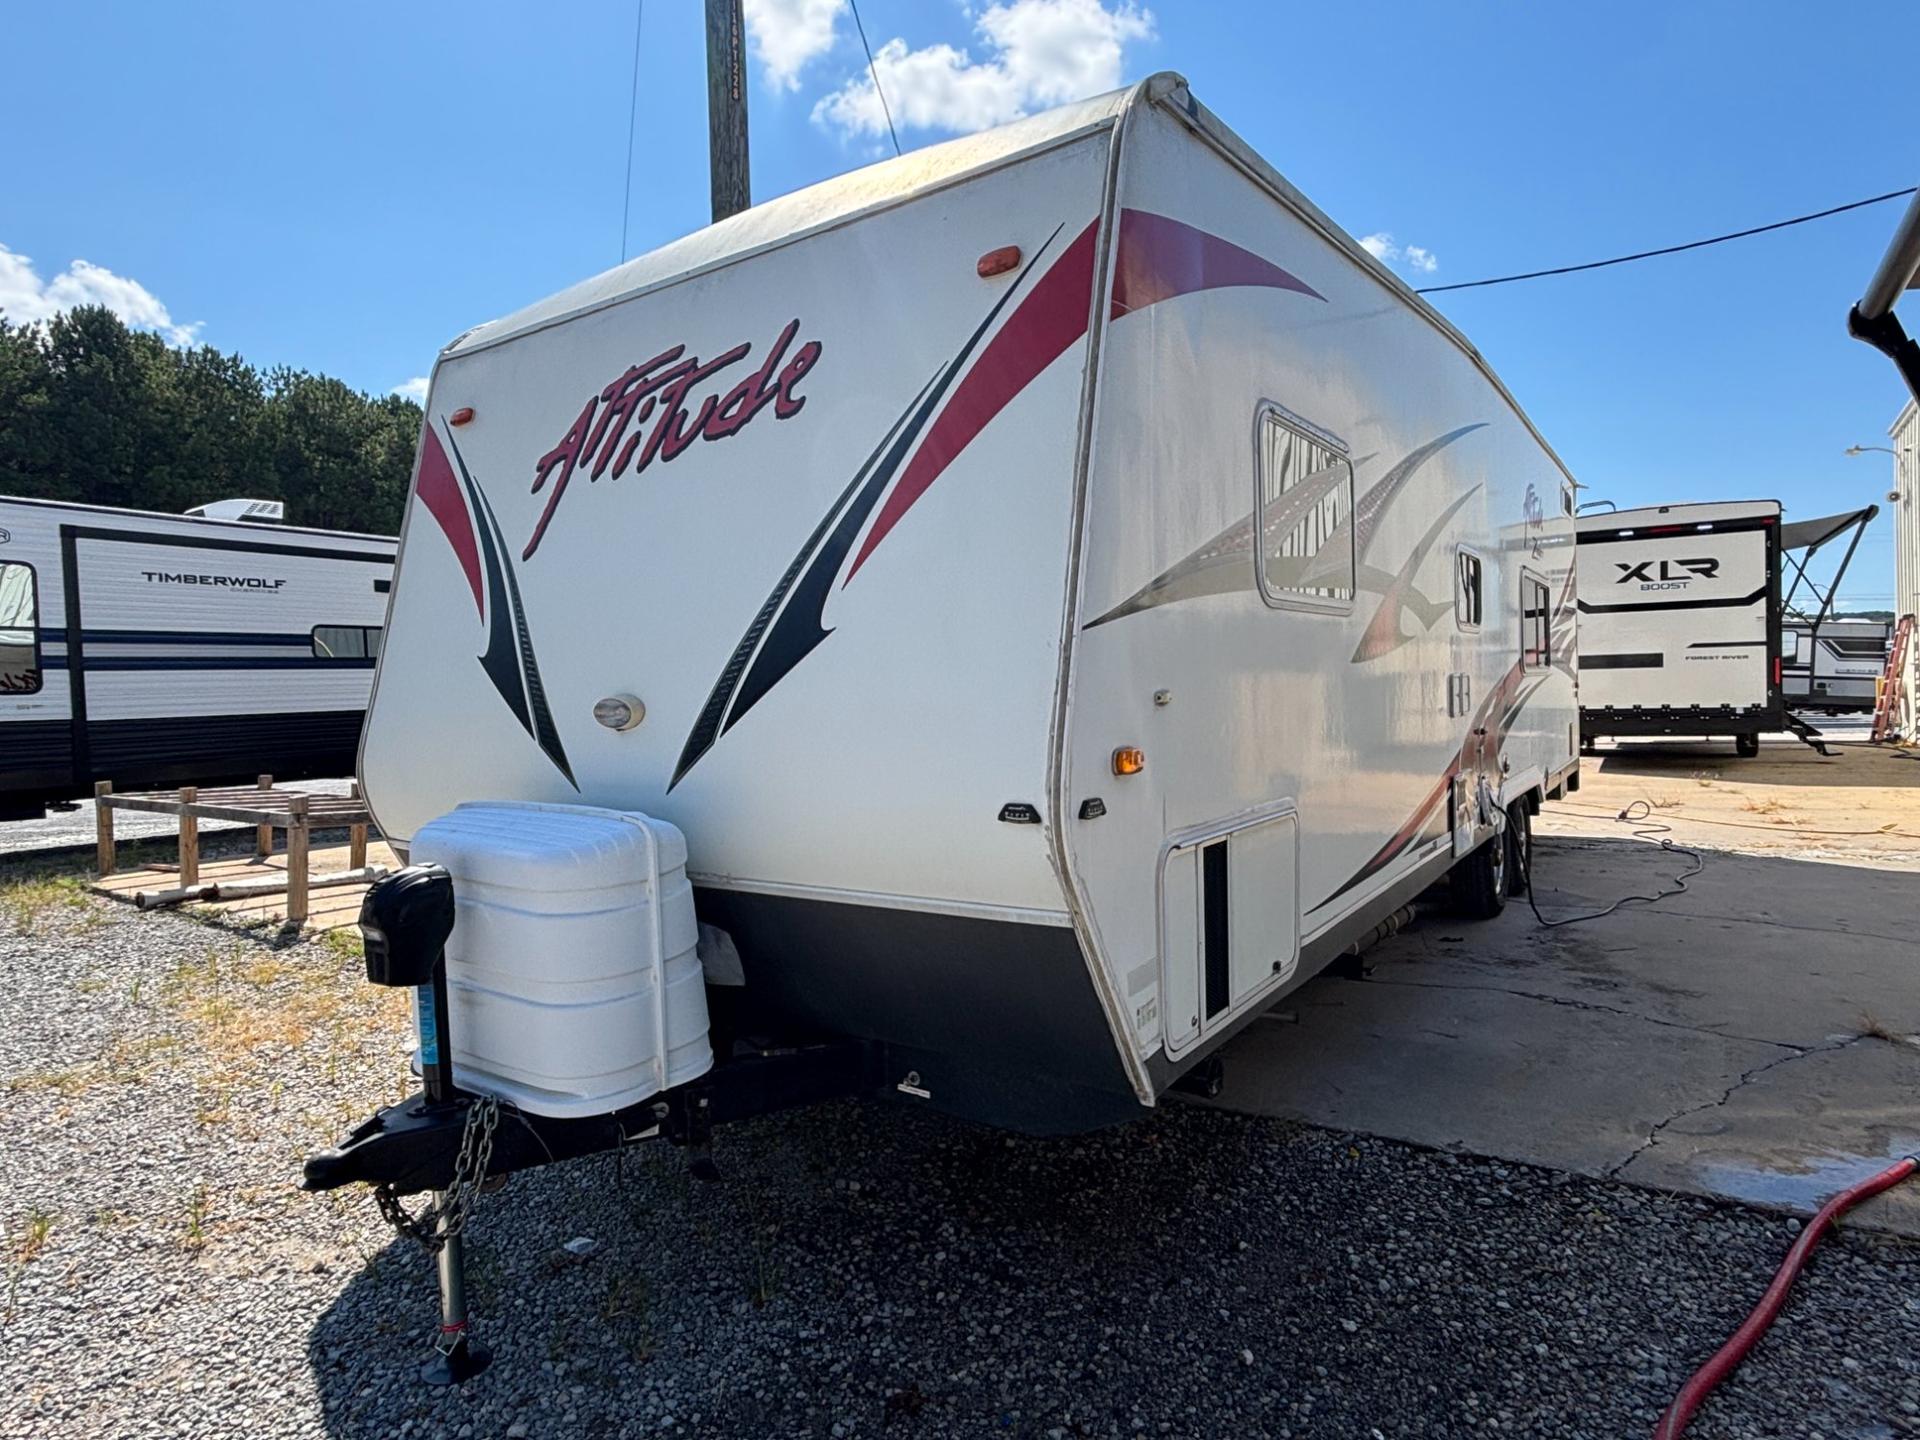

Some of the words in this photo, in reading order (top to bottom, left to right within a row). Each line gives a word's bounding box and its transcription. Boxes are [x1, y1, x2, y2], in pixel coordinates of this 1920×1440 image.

[522, 318, 823, 562] Attitude
[141, 571, 287, 589] TIMBERWOLF
[1614, 558, 1720, 584] XLR
[1640, 582, 1690, 591] BOOST
